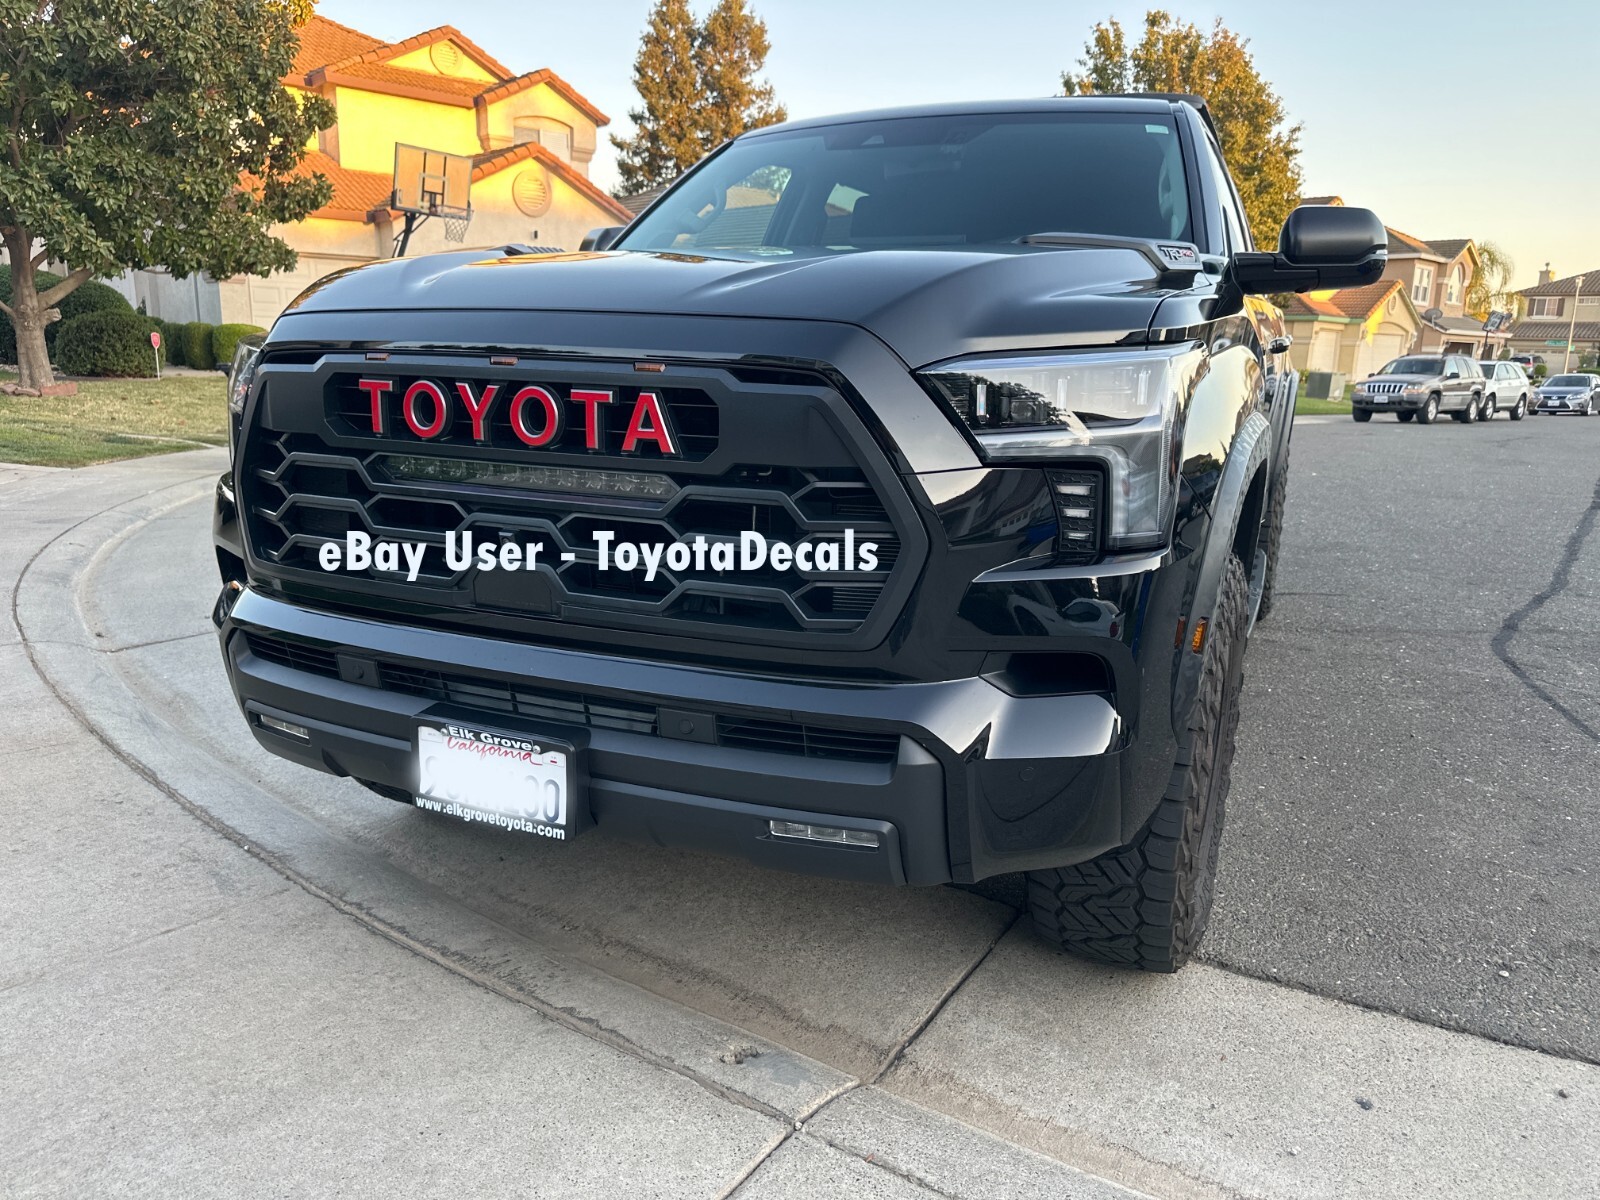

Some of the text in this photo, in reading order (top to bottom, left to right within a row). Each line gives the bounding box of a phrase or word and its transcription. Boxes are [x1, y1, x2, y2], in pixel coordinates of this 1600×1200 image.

[358, 379, 676, 455] TOYOTA
[447, 736, 543, 766] California
[448, 725, 532, 752] Elk Grove
[415, 796, 566, 841] www.elkgrovetoyota.com
